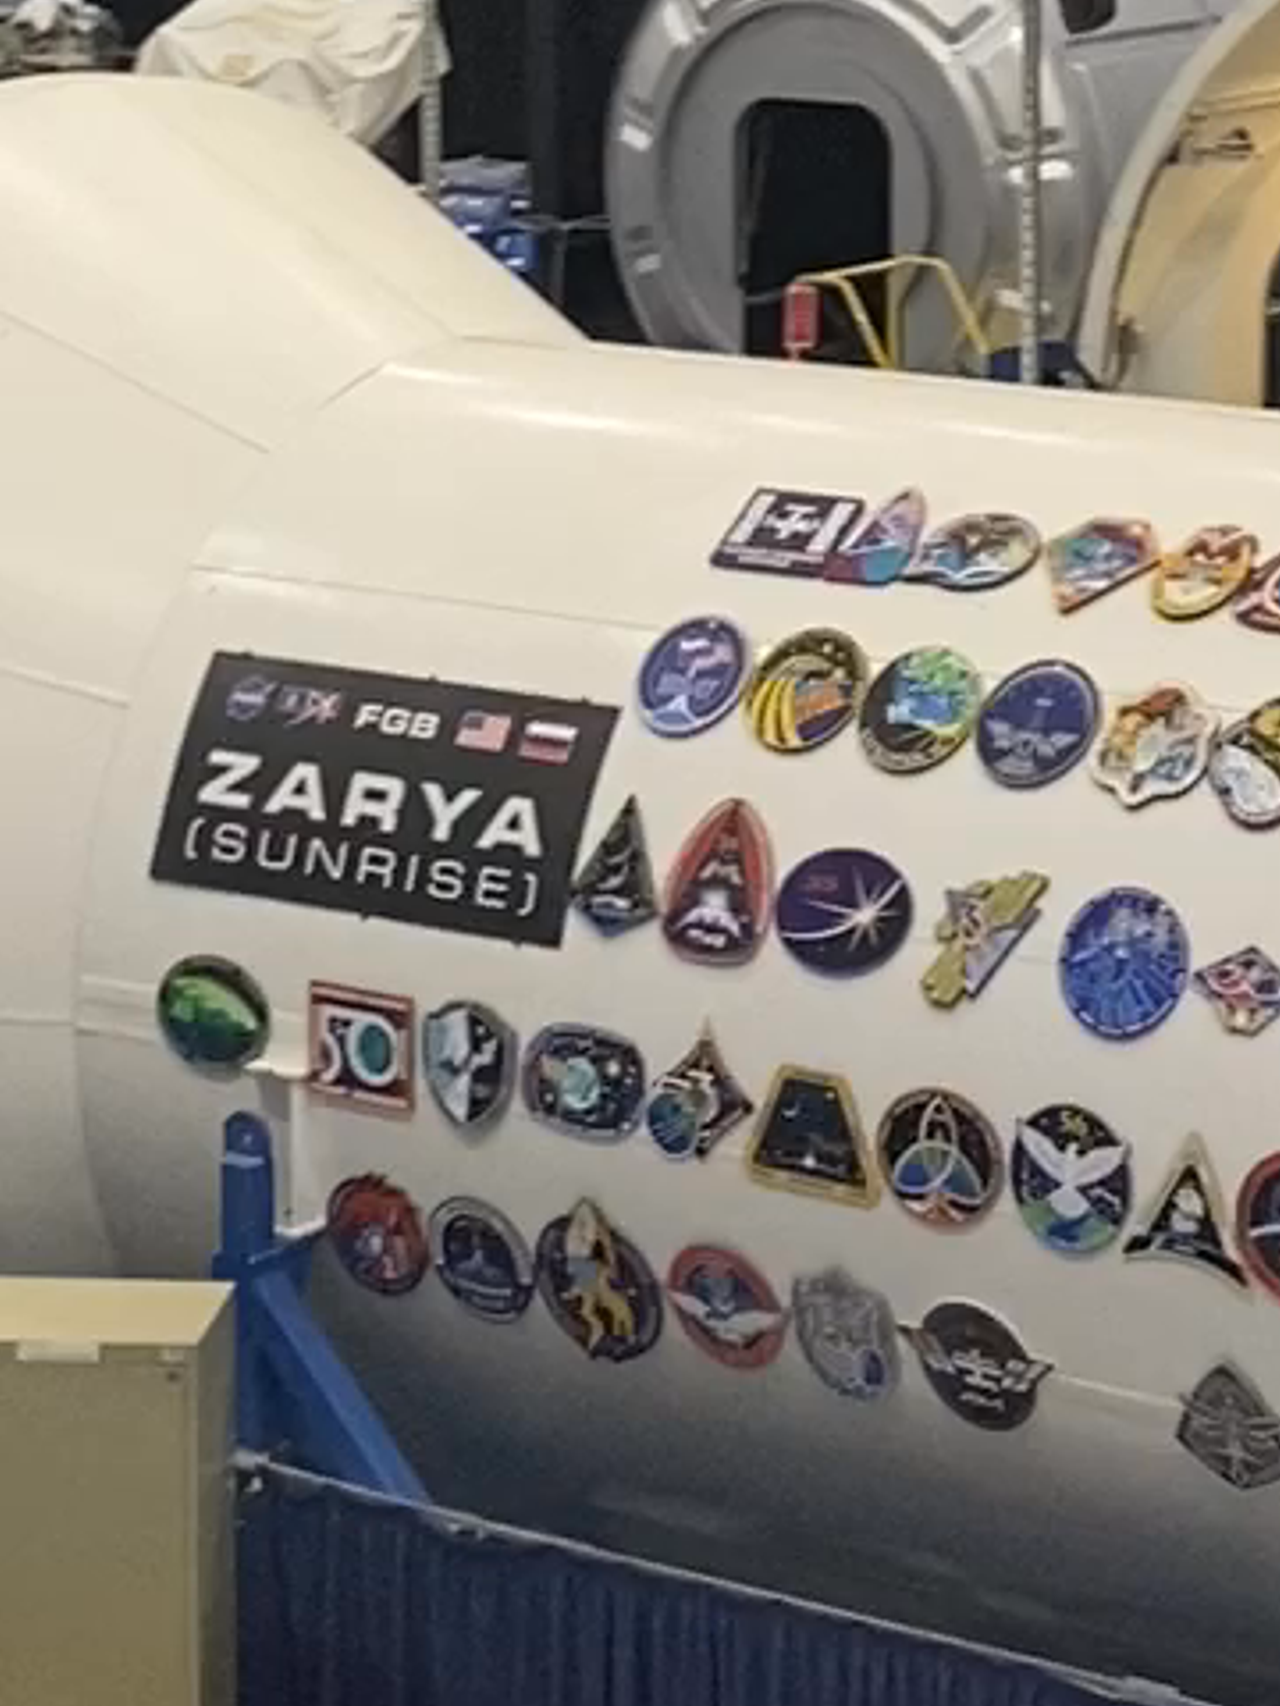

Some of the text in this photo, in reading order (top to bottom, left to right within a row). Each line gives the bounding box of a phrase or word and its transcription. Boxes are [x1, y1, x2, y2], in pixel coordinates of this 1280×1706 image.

[352, 702, 441, 739] FGB
[196, 747, 543, 858] ZARYA
[183, 816, 538, 918] (SUNRISE)
